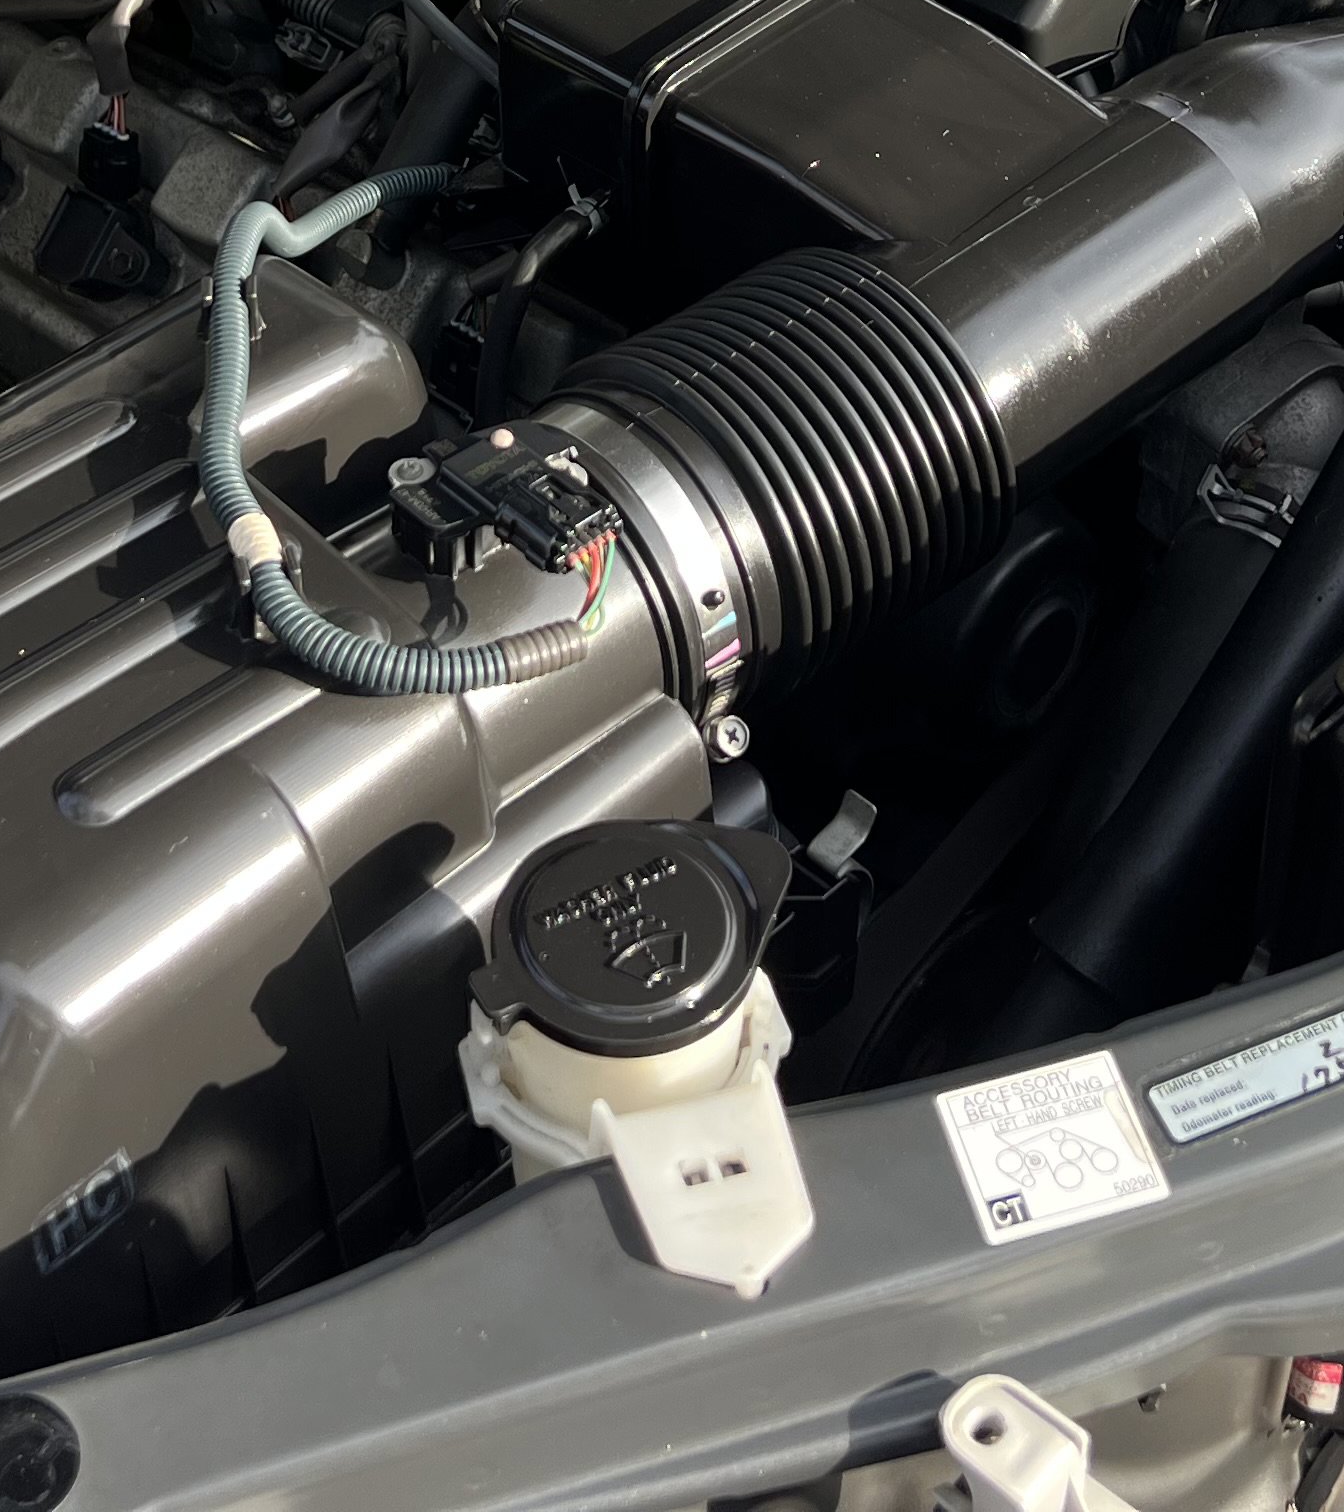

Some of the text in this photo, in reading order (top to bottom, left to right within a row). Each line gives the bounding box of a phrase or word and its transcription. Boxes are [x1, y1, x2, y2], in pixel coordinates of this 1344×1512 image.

[618, 855, 677, 890] FLUID
[1155, 1069, 1202, 1098] TIMING
[1205, 1056, 1239, 1078] BELT
[1242, 1019, 1340, 1064] REPLACEMENT
[963, 1068, 1071, 1110] ACCESSORY
[966, 1075, 1103, 1124] BELT ROUTING
[1062, 1093, 1103, 1115] SCREW
[1171, 1097, 1197, 1117] Date
[1182, 1089, 1277, 1133] Odometer reading:
[1113, 1173, 1154, 1196] 50290
[992, 1195, 1025, 1227] CT
